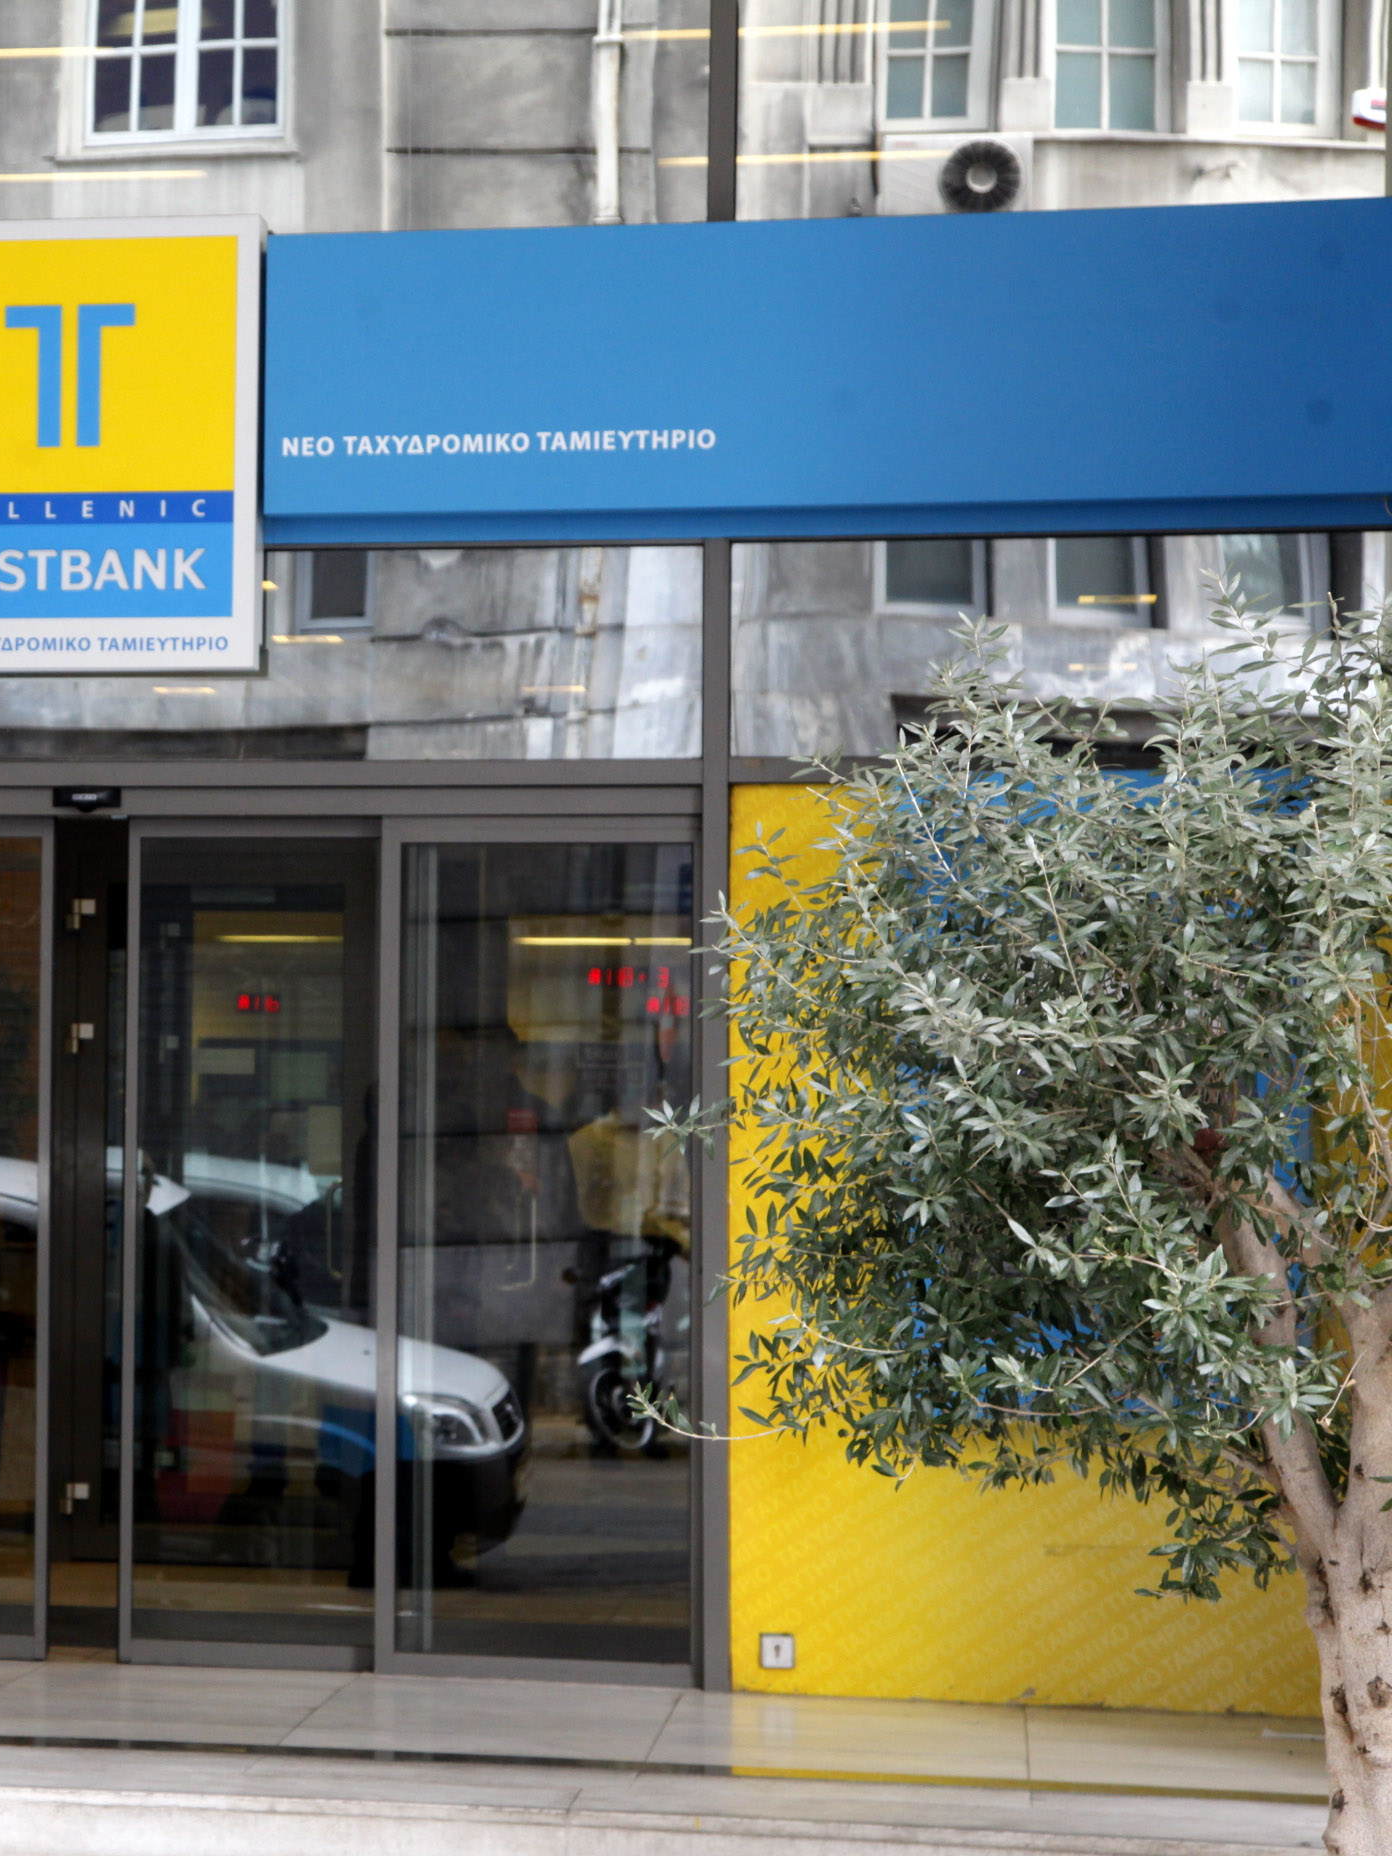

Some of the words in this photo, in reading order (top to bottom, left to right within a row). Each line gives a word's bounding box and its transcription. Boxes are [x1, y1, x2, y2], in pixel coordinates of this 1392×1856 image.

[281, 435, 335, 457] ΝΕΟ
[342, 431, 531, 456] ΤΑΧΥΔΡΟΜΙΚΟ
[535, 428, 717, 451] ΤΑΜΙΕΥΤΗΡΙΟ
[97, 636, 229, 652] ΤΑΜΙΕΥΤΗΡΙΟ
